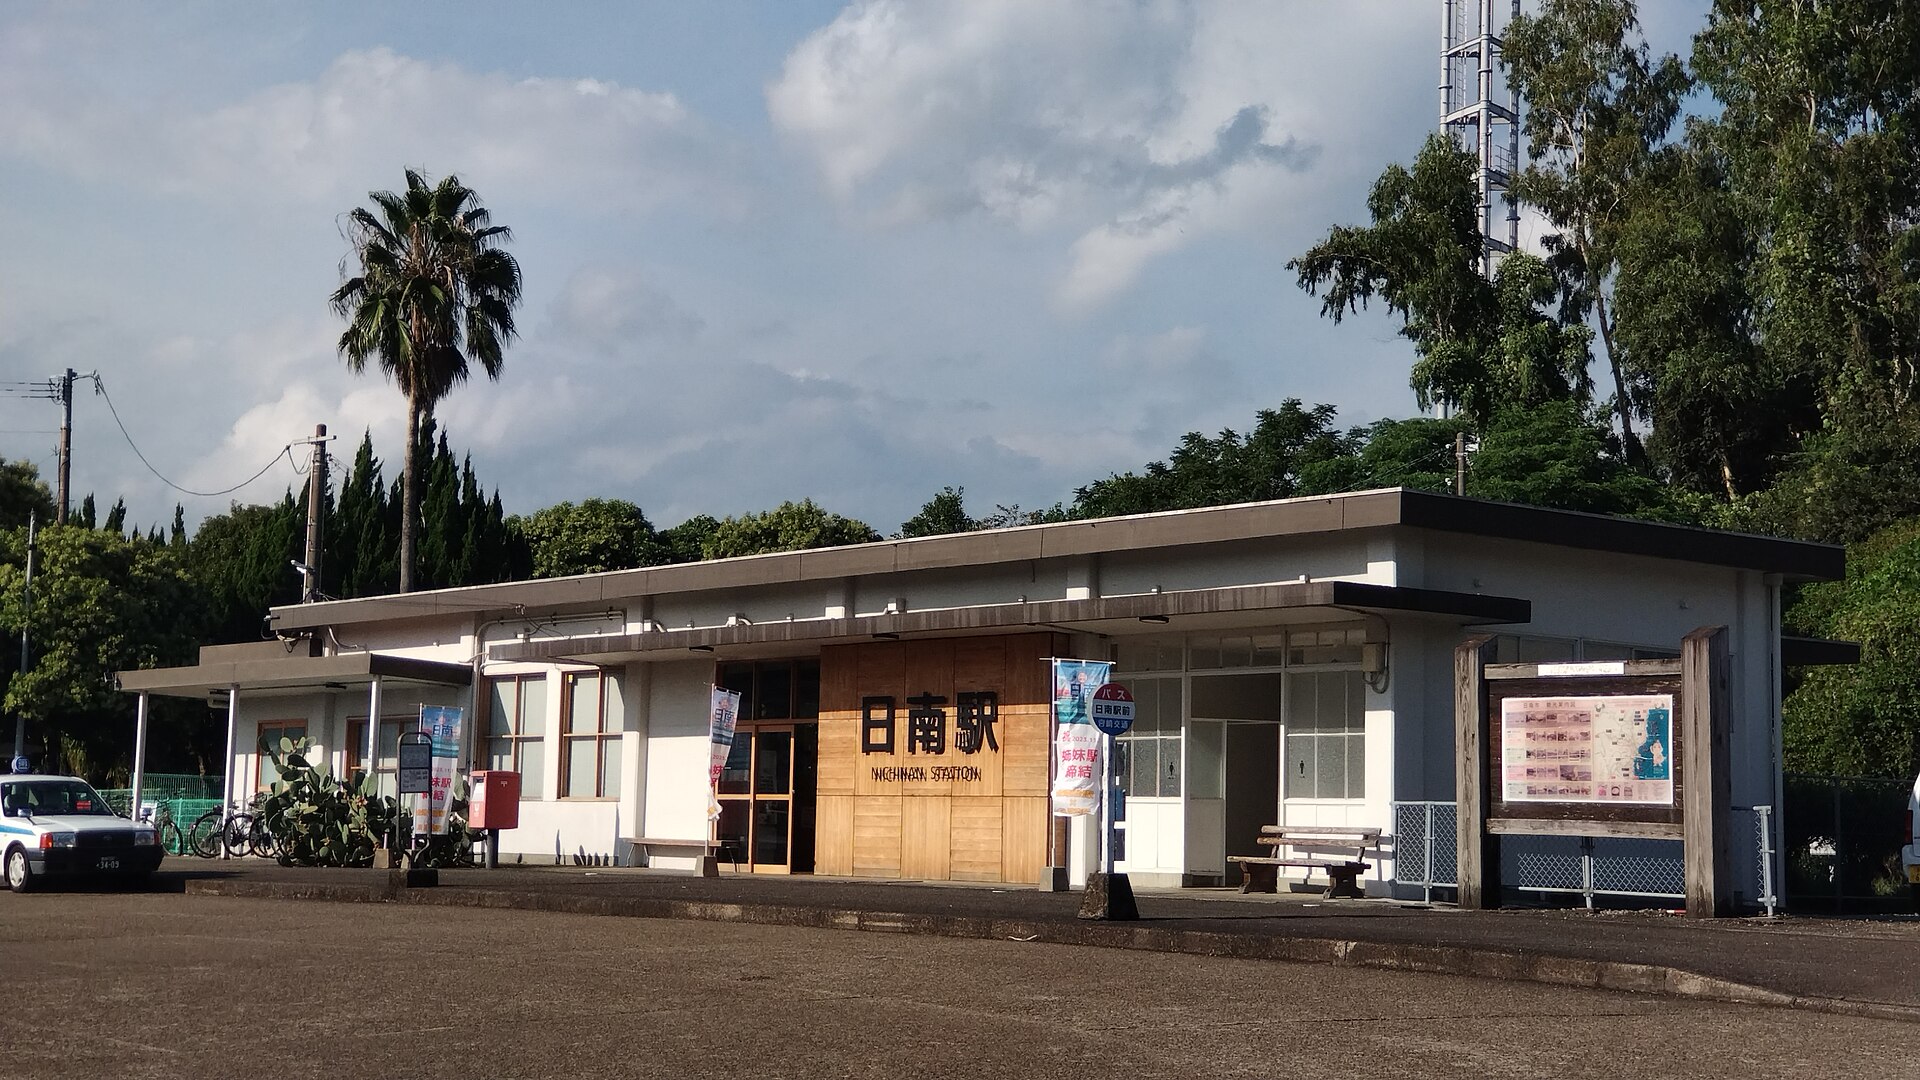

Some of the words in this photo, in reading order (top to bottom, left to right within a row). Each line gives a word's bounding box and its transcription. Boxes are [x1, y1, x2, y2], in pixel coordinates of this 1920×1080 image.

[1102, 689, 1125, 699] バス
[1096, 704, 1130, 716] 日南駅前
[862, 692, 999, 754] 日南駅
[1098, 719, 1128, 729] 宮崎交通
[872, 767, 926, 782] NICHINAN
[931, 766, 981, 782] STATION
